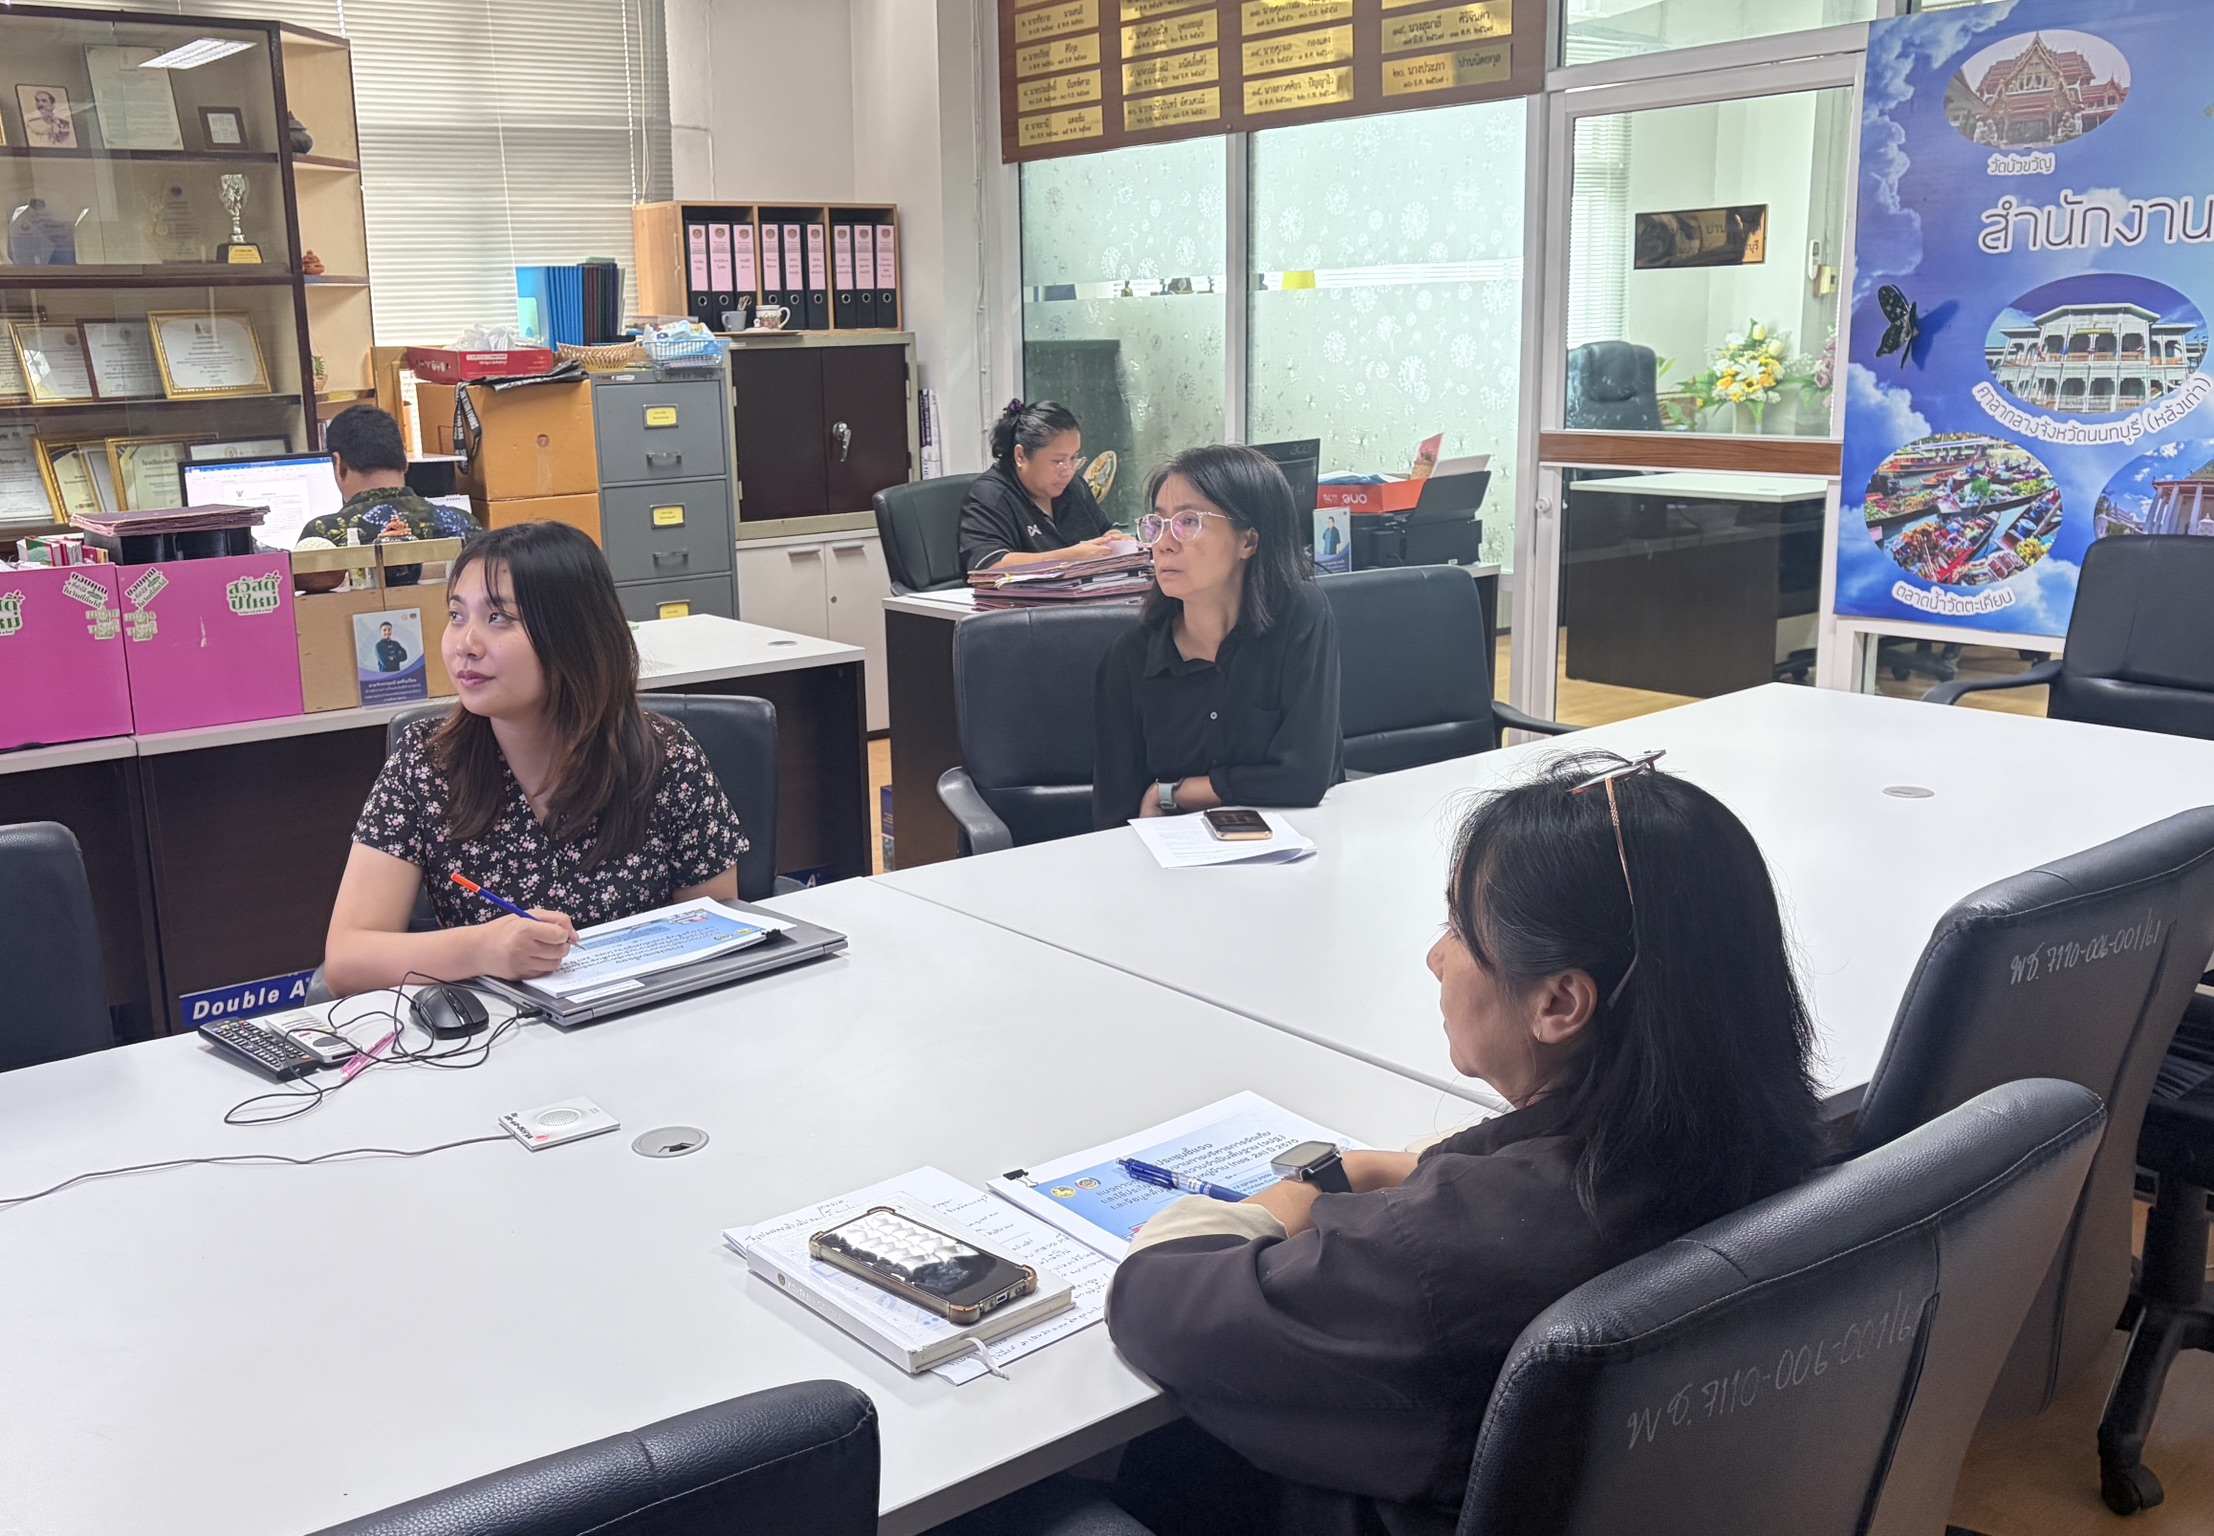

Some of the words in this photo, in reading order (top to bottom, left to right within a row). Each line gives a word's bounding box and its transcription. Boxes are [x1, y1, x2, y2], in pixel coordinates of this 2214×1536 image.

[1990, 155, 2053, 174] วัดบัวขวัญ
[1981, 190, 2214, 250] สำนักงาน
[1976, 384, 2142, 444] ศาลากลางจังหวัดนนทบุรี
[2147, 377, 2212, 431] (หลังเก่า)
[1895, 584, 2013, 613] ตลาดน้ำวัดตะเคียน
[193, 987, 280, 1020] Double
[289, 980, 306, 999] A
[1154, 1143, 1213, 1167] ประชุมชี้แจง
